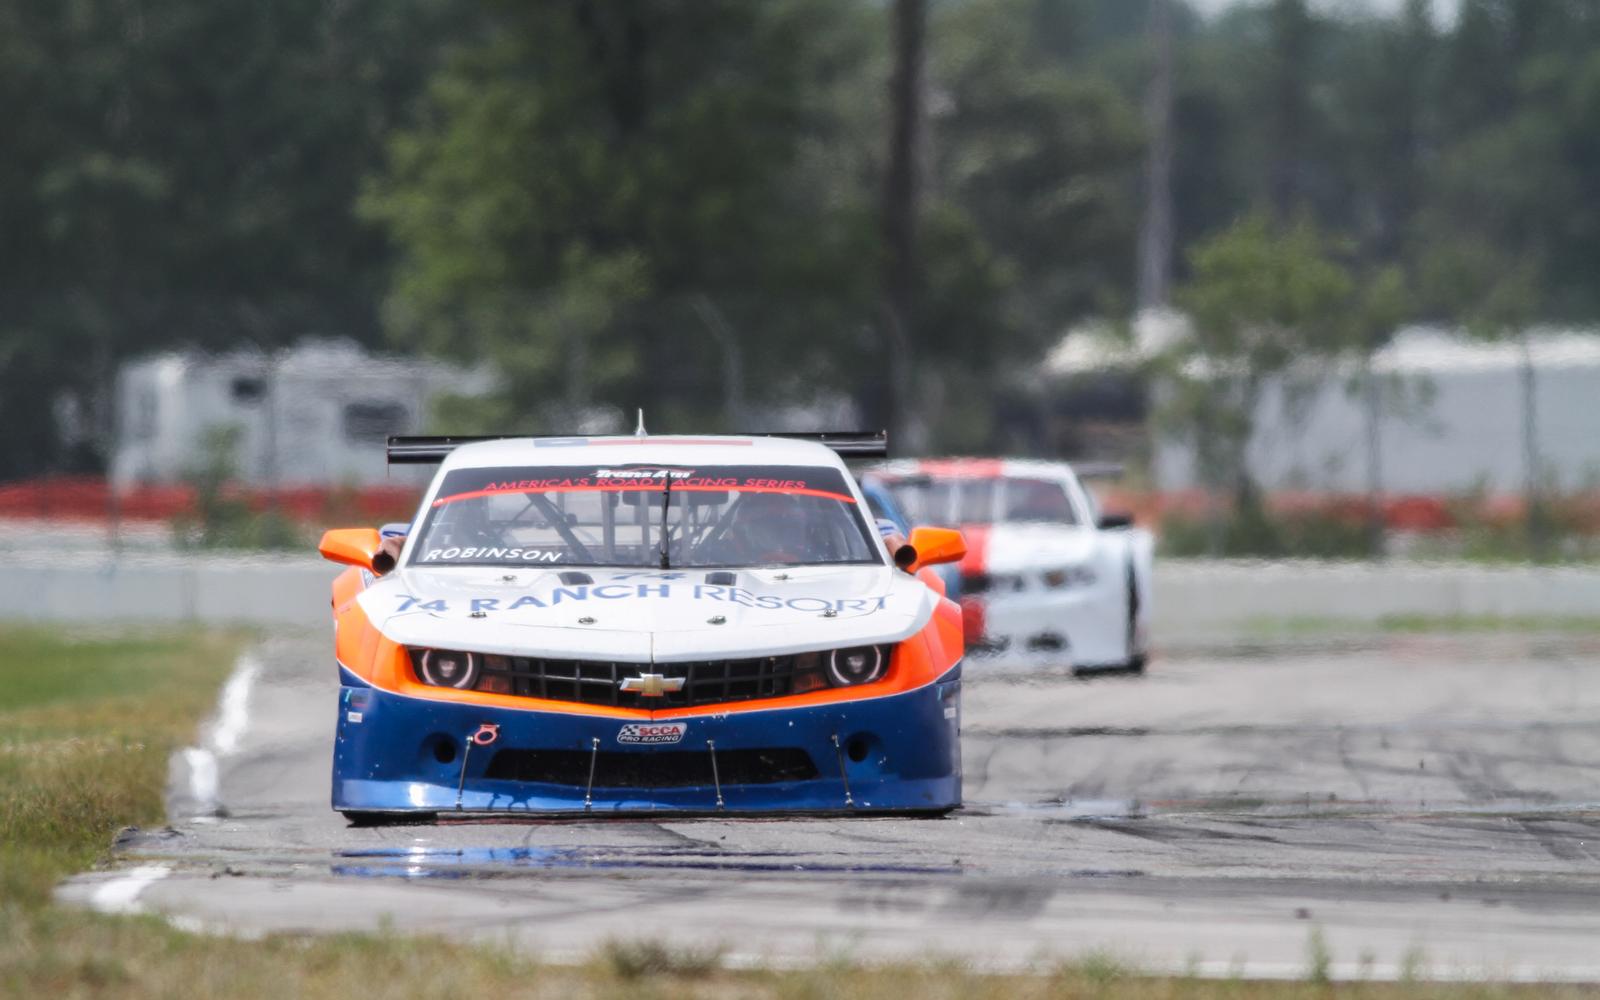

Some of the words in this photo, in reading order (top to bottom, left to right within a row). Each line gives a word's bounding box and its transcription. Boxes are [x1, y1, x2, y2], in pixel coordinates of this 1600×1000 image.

[483, 478, 590, 491] AMERICA'S
[596, 478, 653, 486] ROAD
[743, 479, 806, 489] SERIES
[424, 547, 562, 562] ROBINSON
[611, 572, 687, 580] 74
[395, 595, 449, 612] 74
[470, 585, 671, 612] RANCH
[694, 584, 893, 612] RESORT
[639, 726, 680, 735] SCCA
